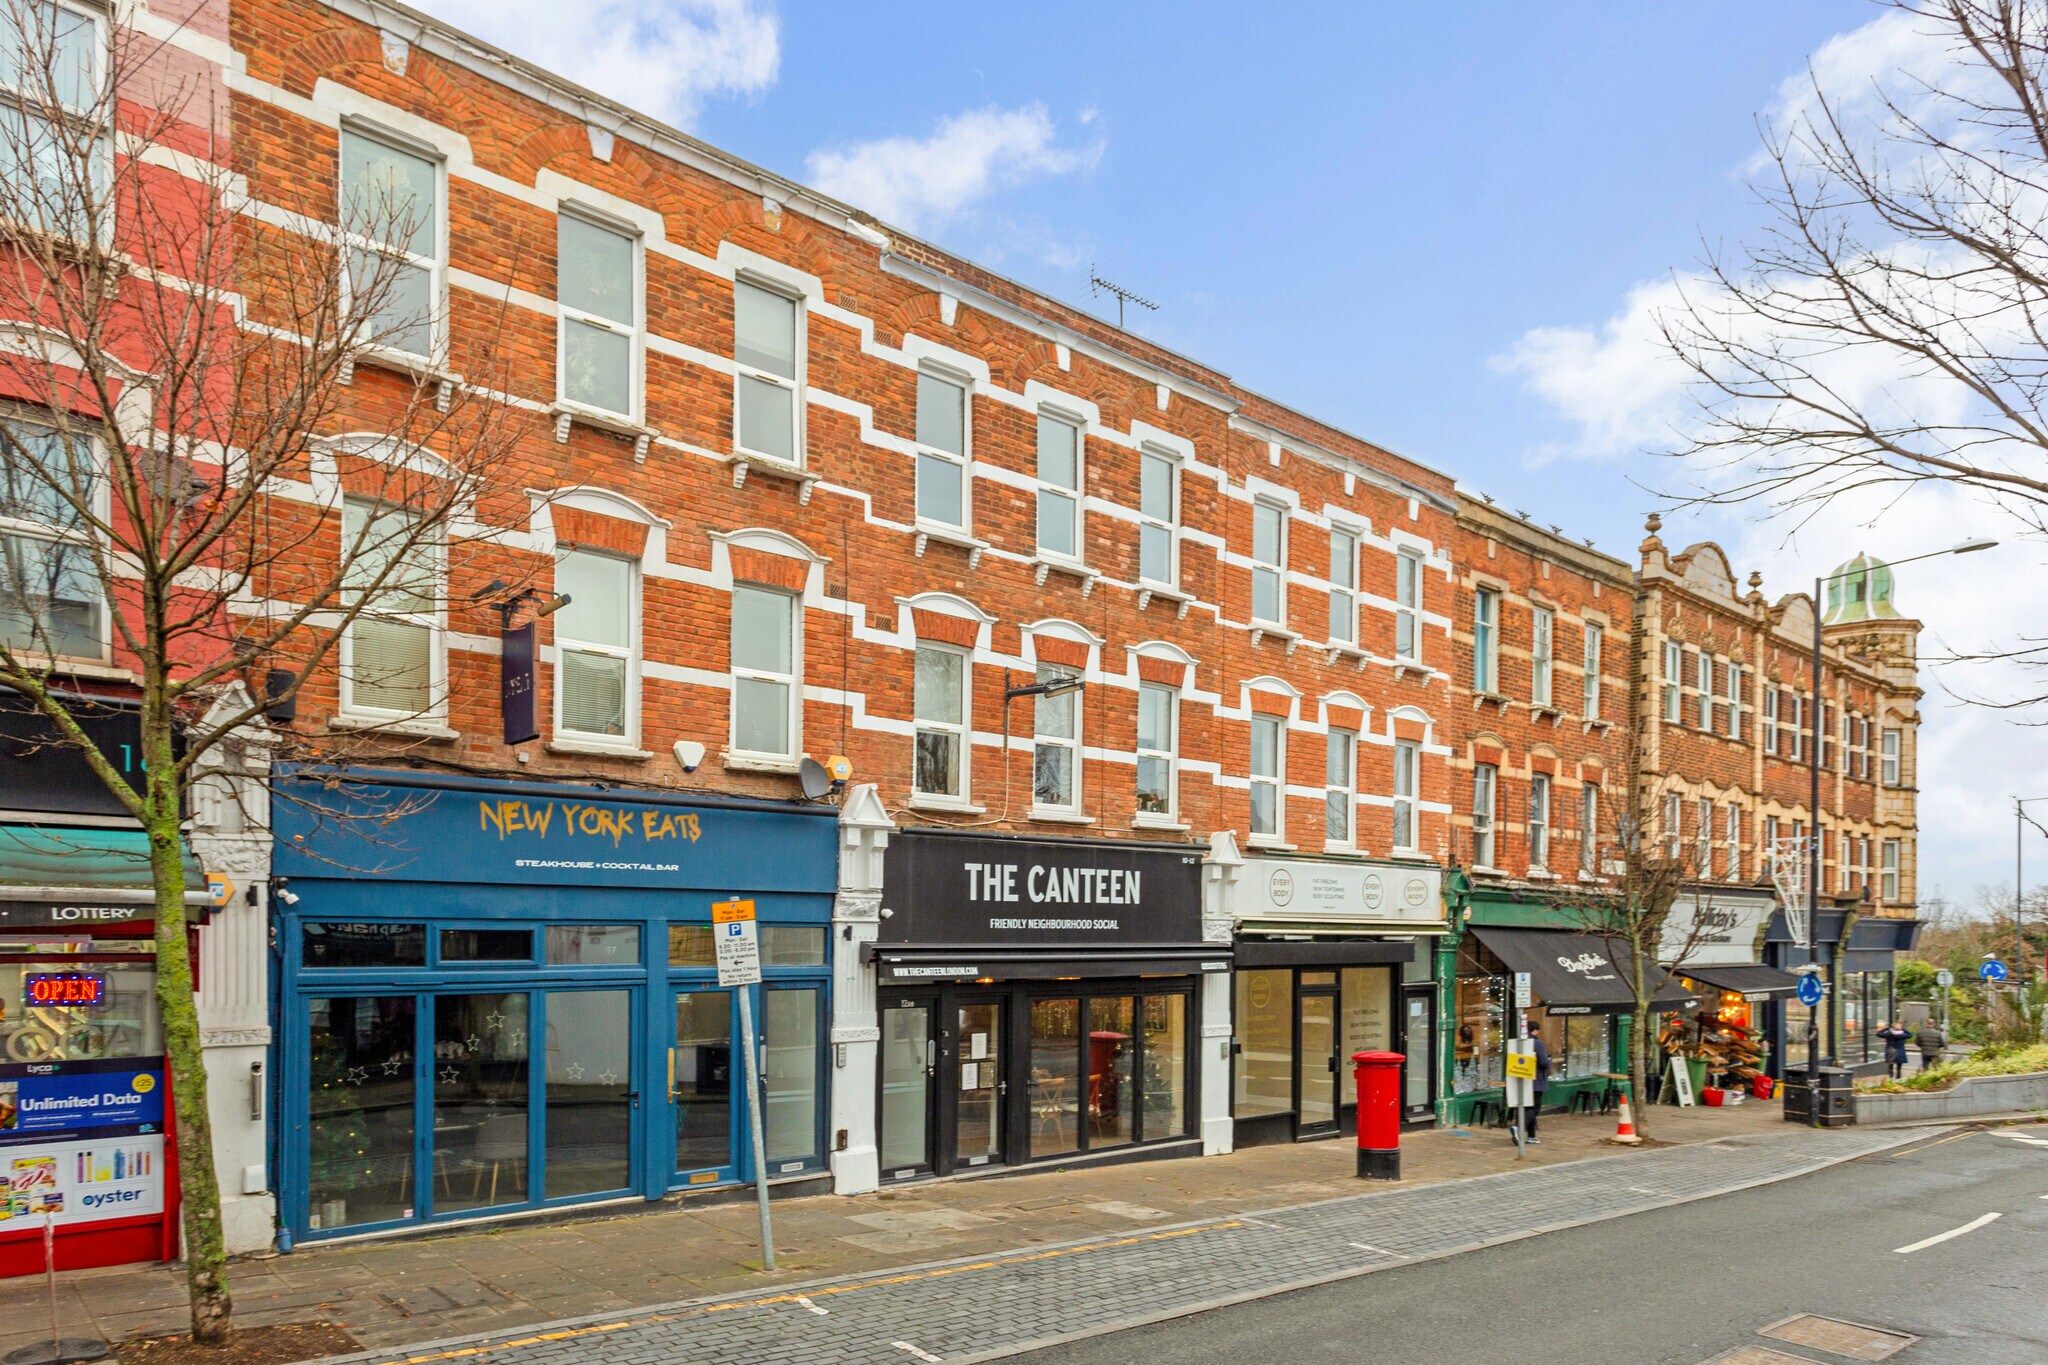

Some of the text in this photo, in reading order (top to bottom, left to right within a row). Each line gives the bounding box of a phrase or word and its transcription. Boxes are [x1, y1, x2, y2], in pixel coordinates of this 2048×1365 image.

[480, 800, 701, 848] NEW YORK EATS
[515, 859, 595, 869] STEAKHOUSE
[602, 862, 654, 870] COCKTAIL
[964, 863, 1141, 904] THE CANTEEN
[51, 907, 135, 920] LOTTERY
[731, 925, 740, 935] P
[990, 918, 1119, 930] FRIENDLY NEIGHBOURHOOD SOCIAL
[33, 981, 97, 1001] OPEN
[27, 1065, 53, 1074] Lyca
[20, 1093, 142, 1111] Unlimited Data
[82, 1189, 142, 1208] oyster
